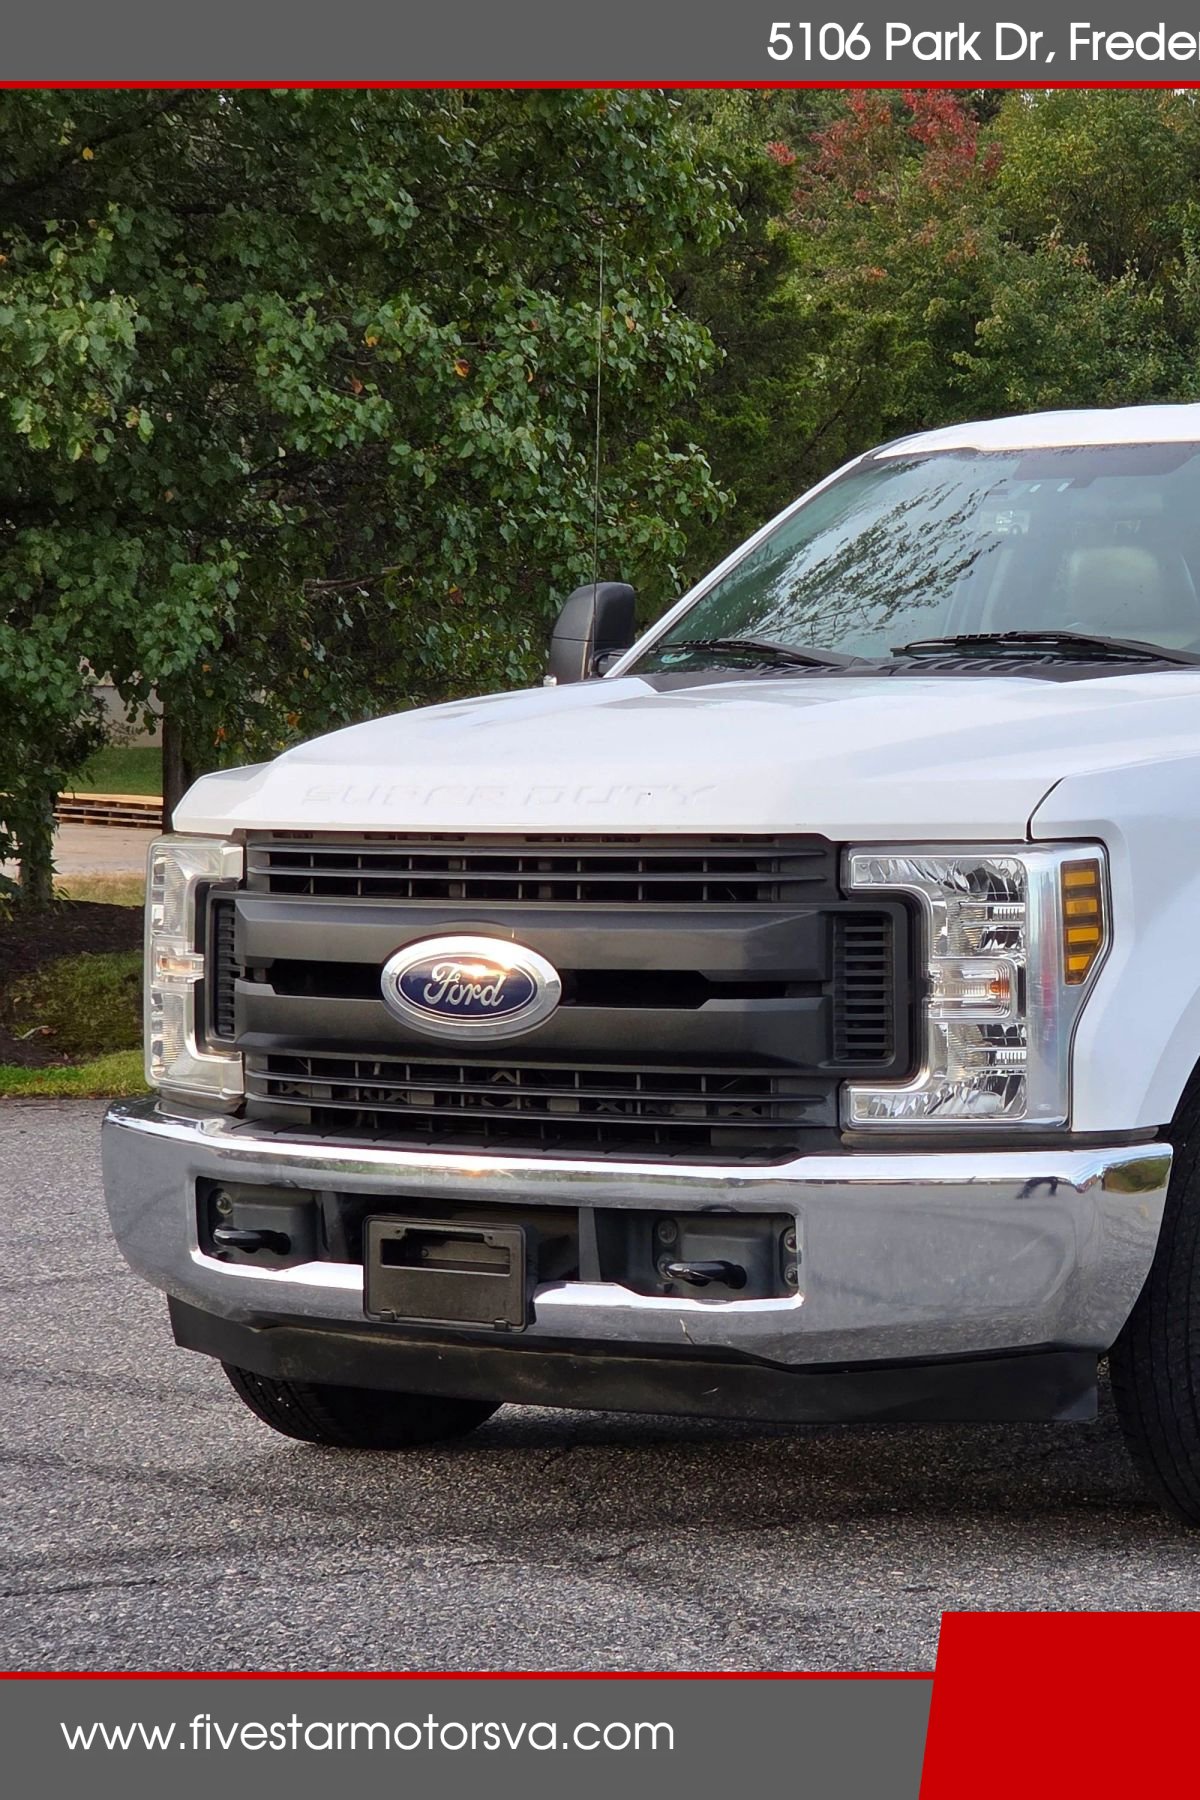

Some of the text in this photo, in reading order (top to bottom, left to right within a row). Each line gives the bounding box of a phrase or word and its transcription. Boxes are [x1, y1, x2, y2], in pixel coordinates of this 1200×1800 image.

[301, 783, 720, 807] SUPER DUTY
[423, 961, 508, 1007] Ford
